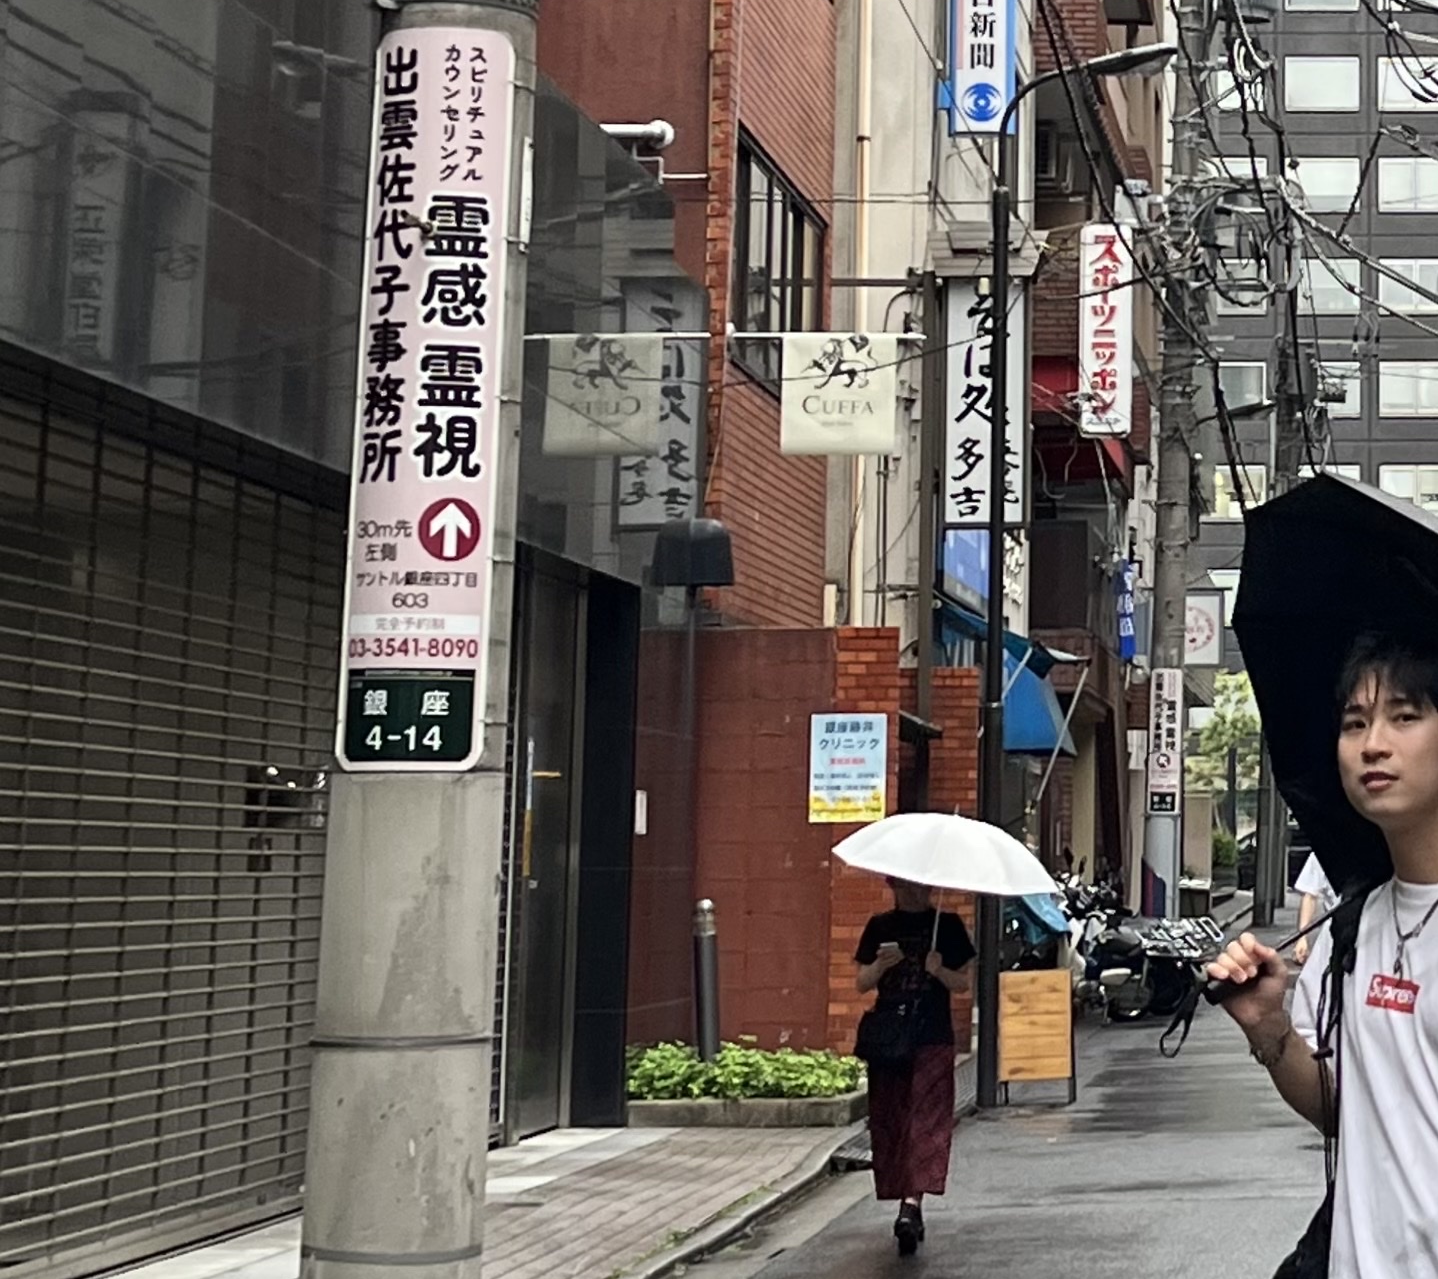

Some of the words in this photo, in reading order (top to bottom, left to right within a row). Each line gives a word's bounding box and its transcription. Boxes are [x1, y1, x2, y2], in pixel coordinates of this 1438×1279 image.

[439, 43, 461, 182] カウンセリング
[463, 46, 488, 182] スピリチュアル
[359, 46, 419, 484] 出雲佐代子事務所
[421, 194, 489, 326] 霊感
[413, 344, 483, 478] 霊視
[802, 395, 874, 416] CUFFA
[391, 592, 429, 609] 603
[349, 636, 479, 659] 03-3541-8090
[364, 724, 444, 752] 4-14
[819, 737, 881, 751] クリニック
